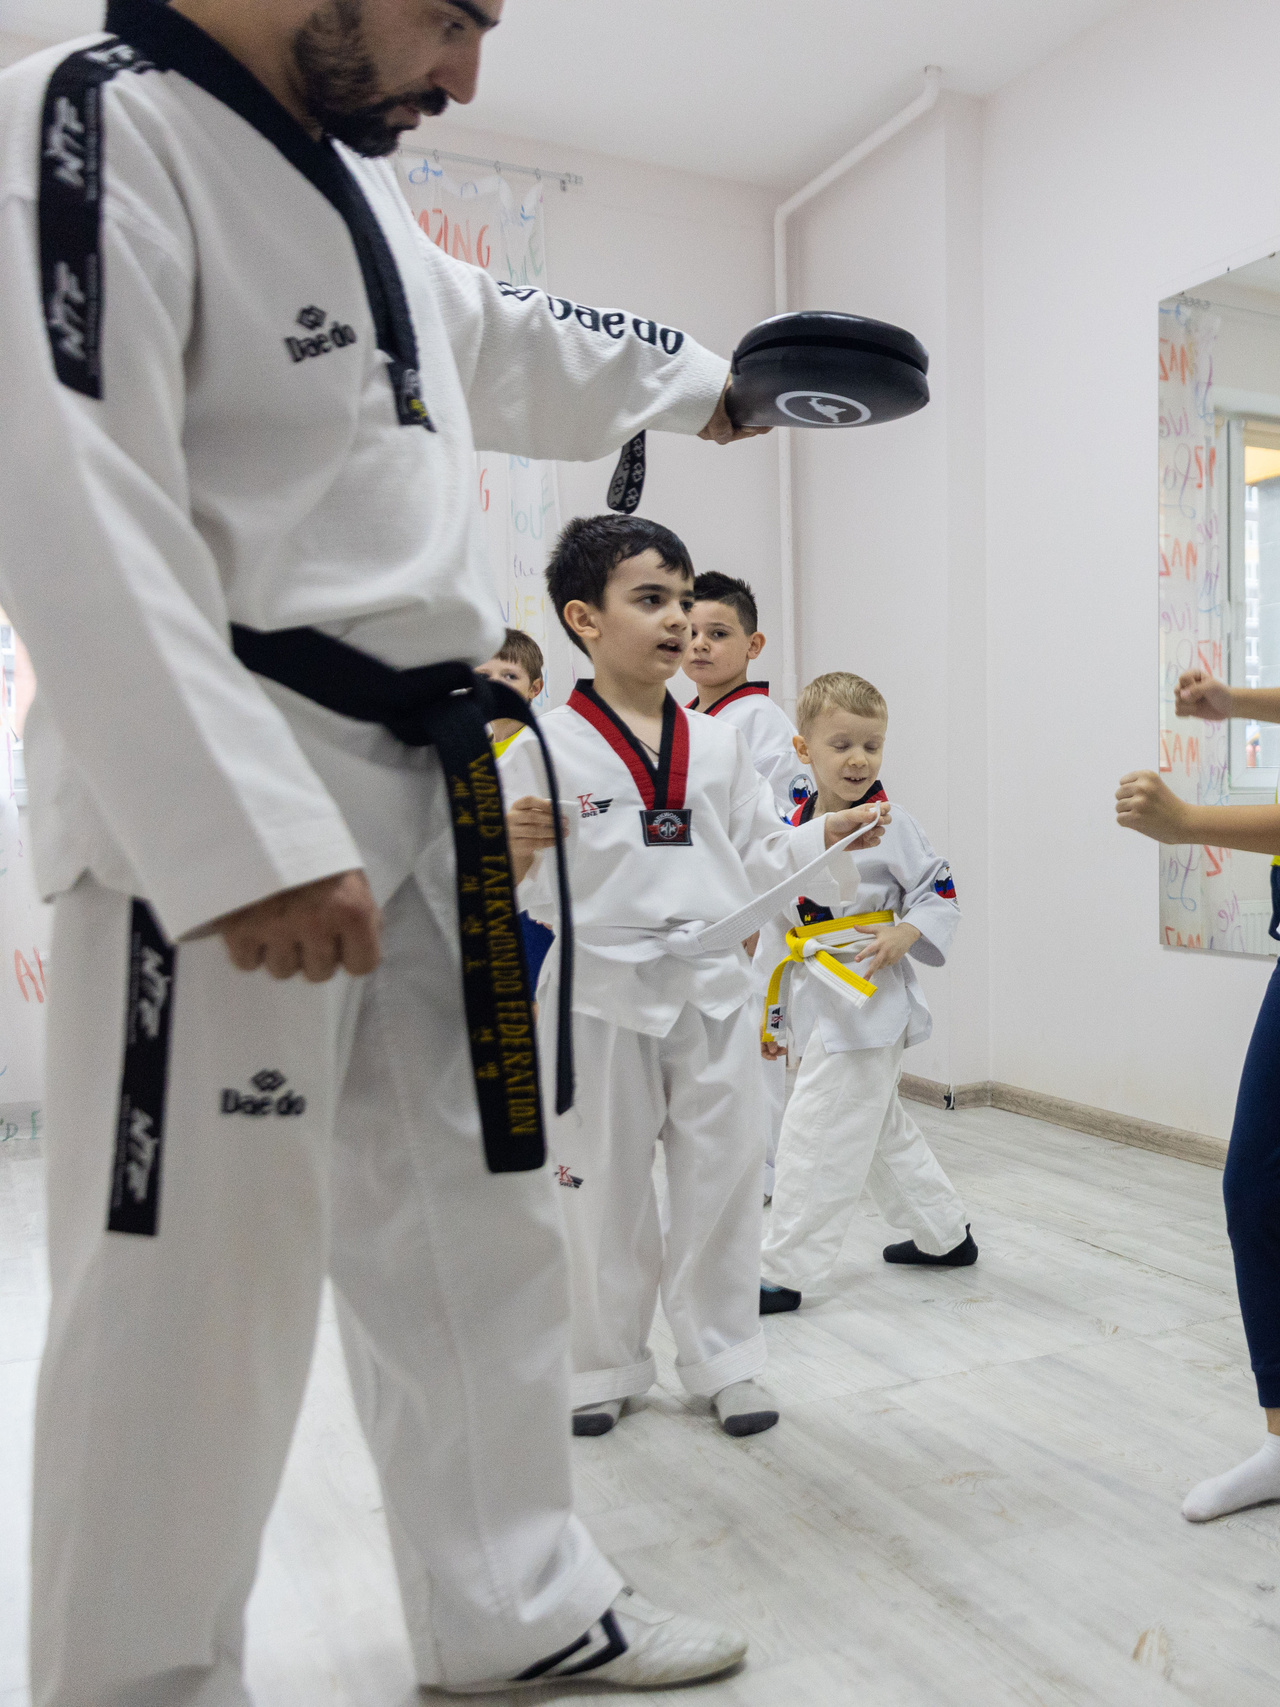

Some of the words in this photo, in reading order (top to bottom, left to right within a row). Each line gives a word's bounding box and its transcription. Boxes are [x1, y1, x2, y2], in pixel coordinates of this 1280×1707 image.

[468, 752, 503, 838] WORLD
[581, 810, 598, 819] ONE
[480, 855, 523, 994] TAEKWONDO
[496, 1000, 538, 1135] FEDERATION
